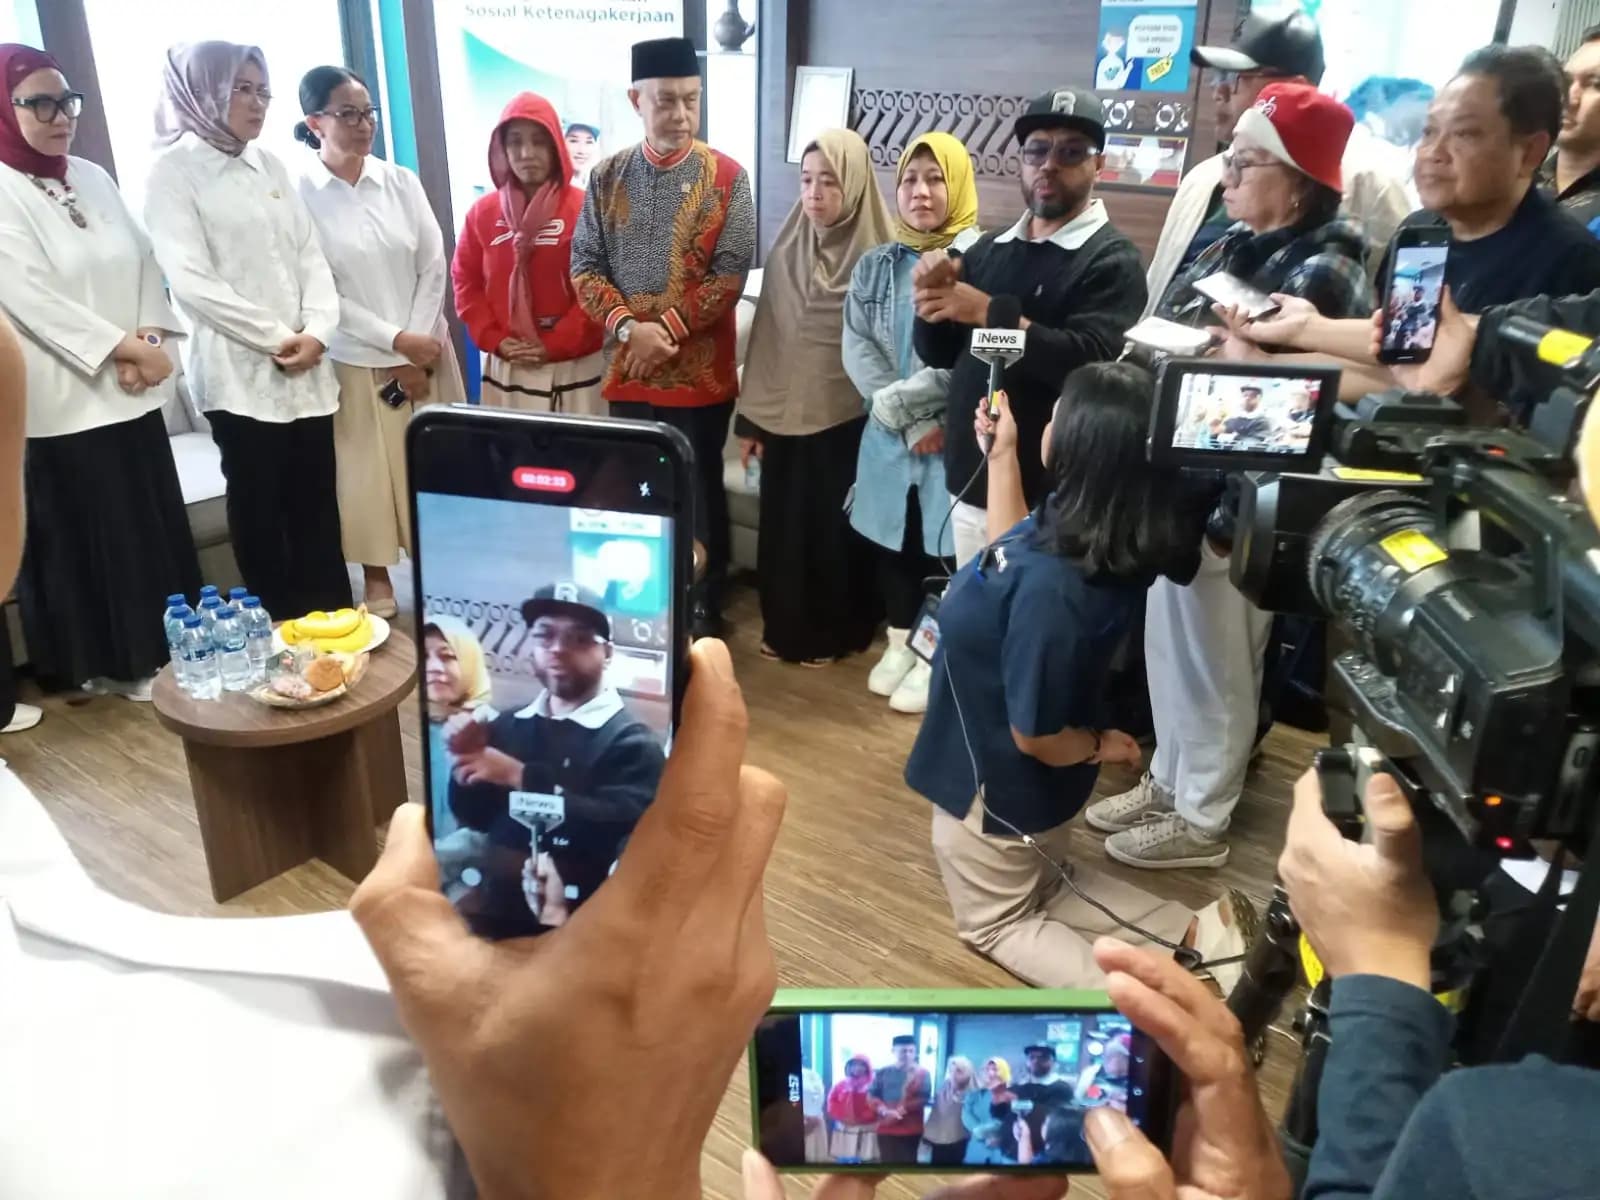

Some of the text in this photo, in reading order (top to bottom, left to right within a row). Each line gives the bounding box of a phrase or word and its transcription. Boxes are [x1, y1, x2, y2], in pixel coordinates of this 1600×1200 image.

[465, 5, 674, 23] Sosial Ketenagakerjaan
[1051, 91, 1076, 115] R
[978, 332, 1017, 345] iNews
